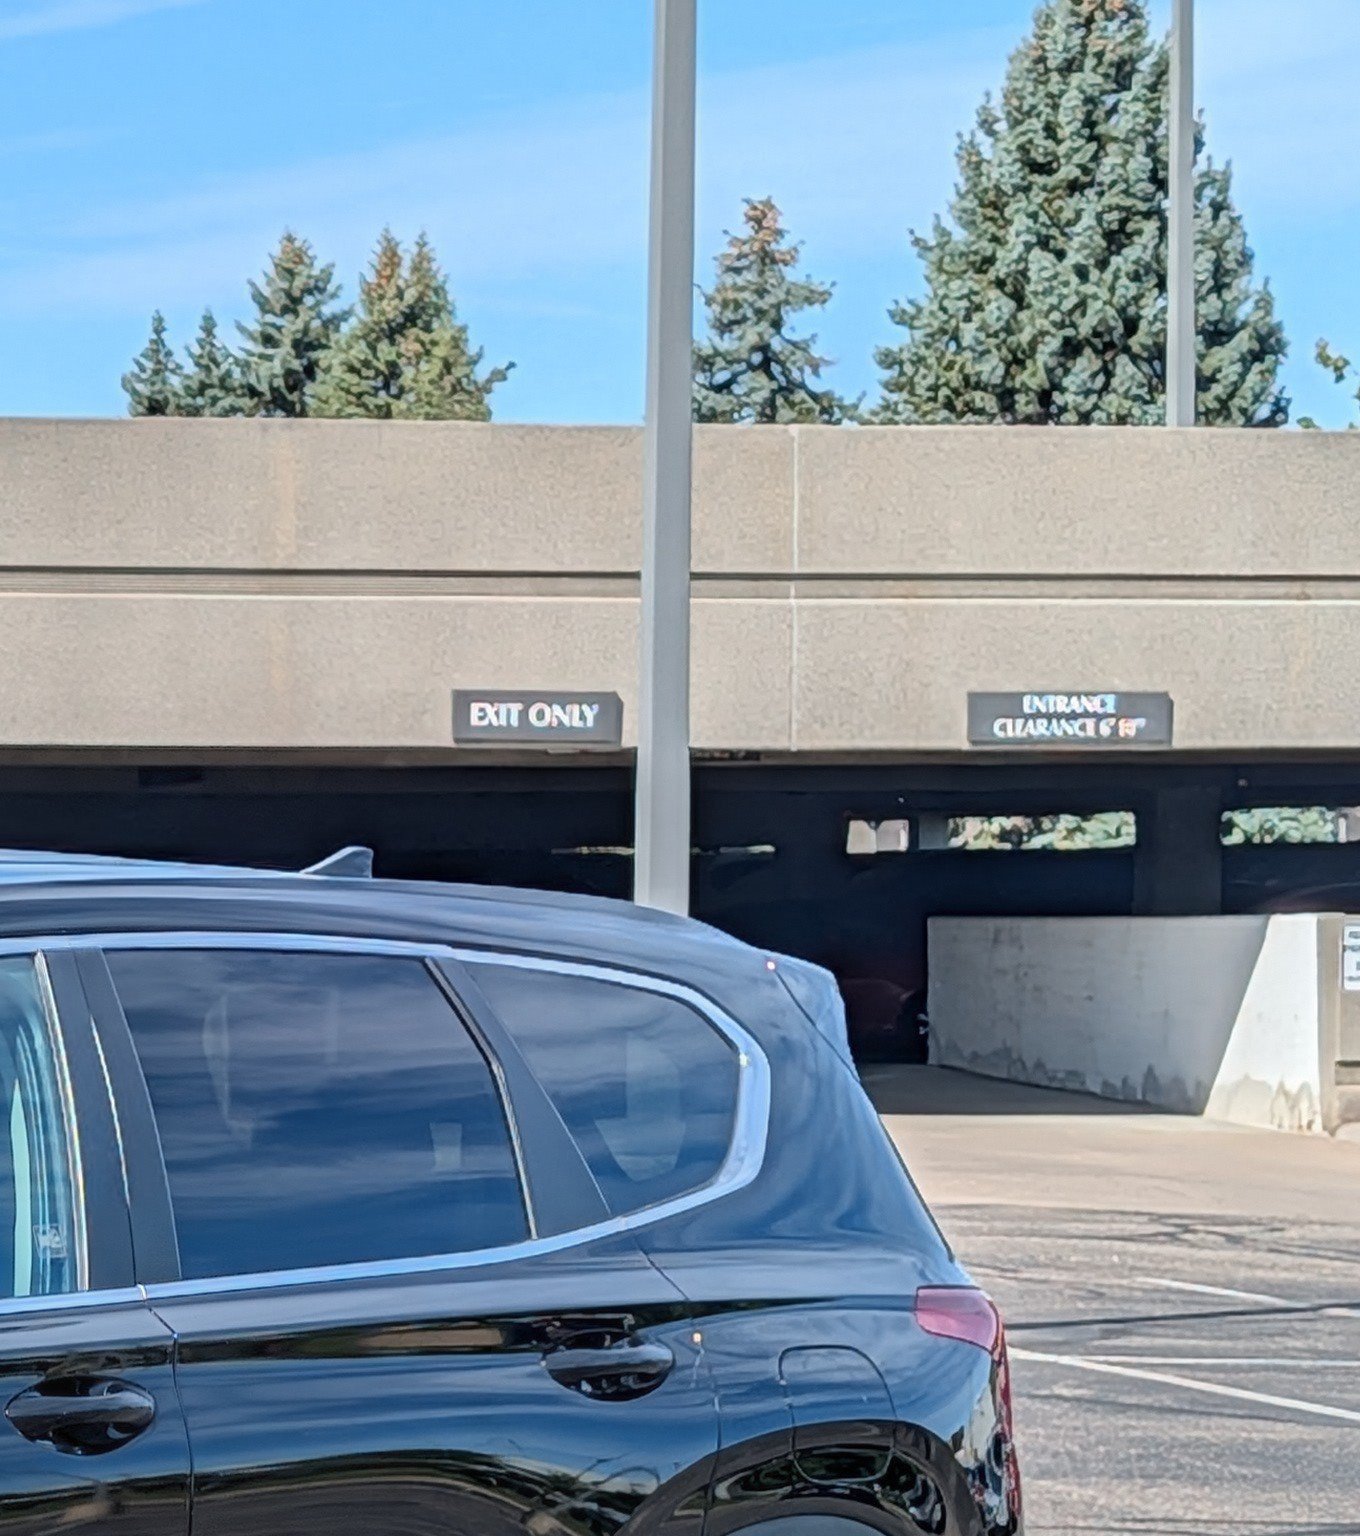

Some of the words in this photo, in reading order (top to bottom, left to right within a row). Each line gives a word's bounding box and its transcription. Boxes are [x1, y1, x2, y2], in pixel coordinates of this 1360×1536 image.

[1022, 694, 1117, 714] ENTRANCE
[469, 702, 524, 727] EXIT
[528, 702, 600, 728] ONLY
[992, 717, 1097, 738] CLEARANCE
